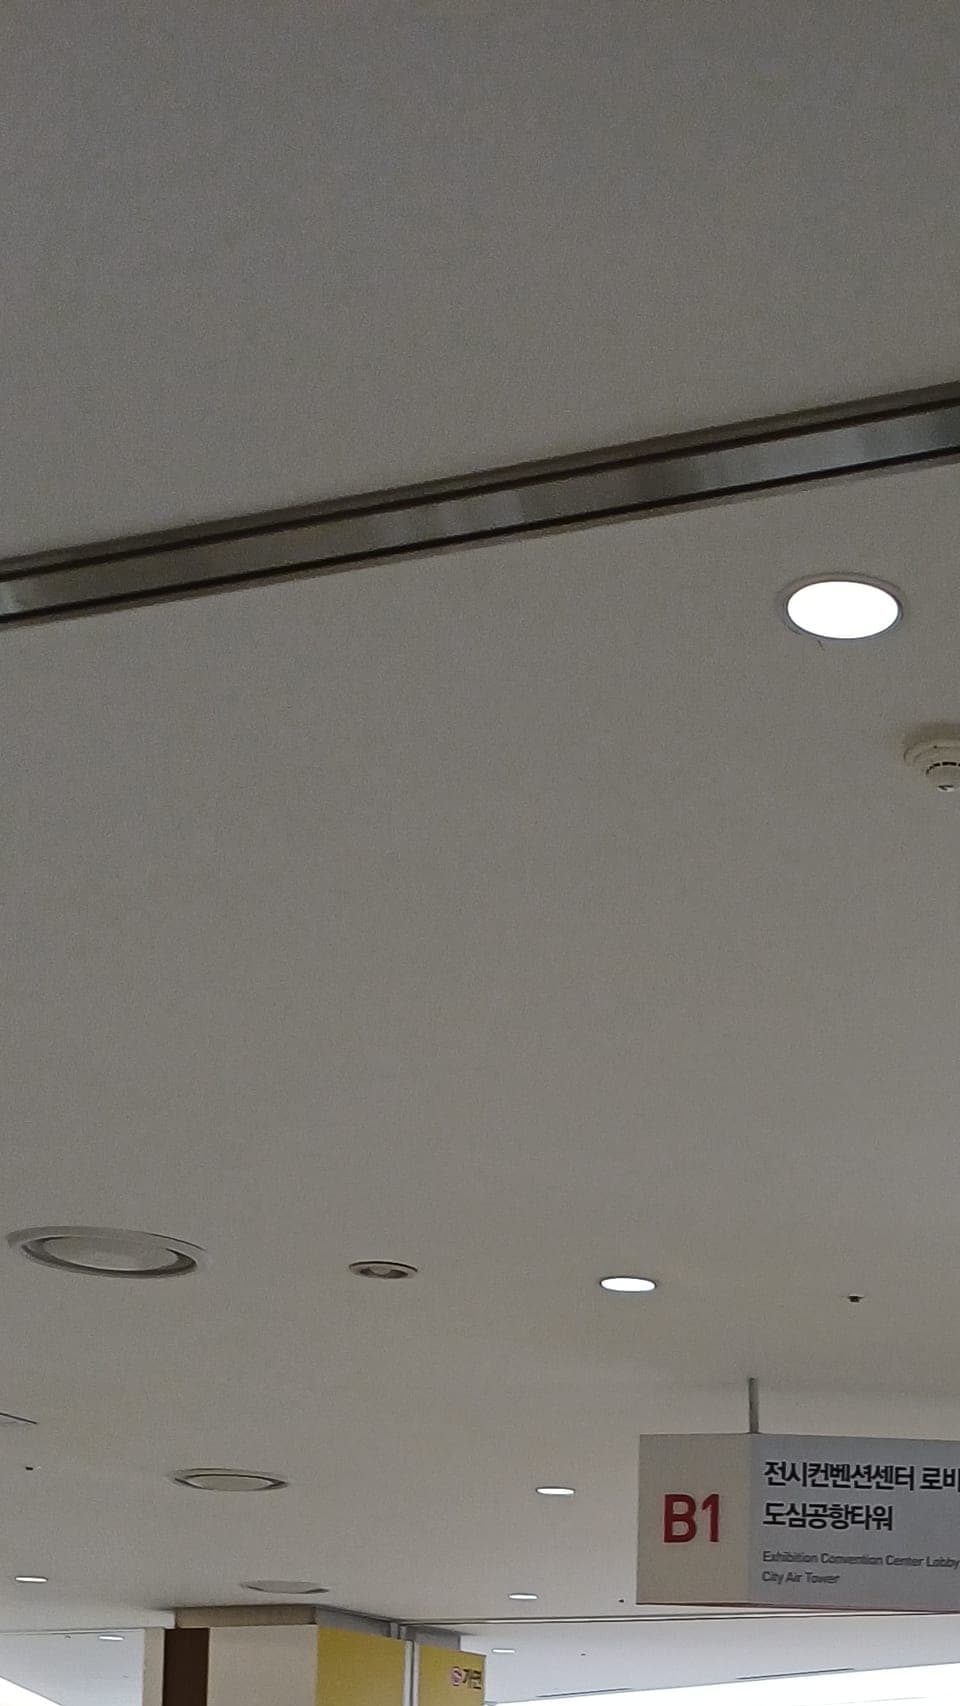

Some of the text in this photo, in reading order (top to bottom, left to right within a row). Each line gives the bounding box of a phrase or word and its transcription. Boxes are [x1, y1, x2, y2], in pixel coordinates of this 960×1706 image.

[764, 1460, 915, 1491] 전시컨벤션센터
[662, 1493, 720, 1544] B1
[762, 1502, 893, 1531] 도심공항타워
[762, 1550, 819, 1563] Exhibition
[820, 1552, 883, 1566] Convention
[885, 1555, 925, 1567] Center
[762, 1570, 841, 1584] City Air Tower
